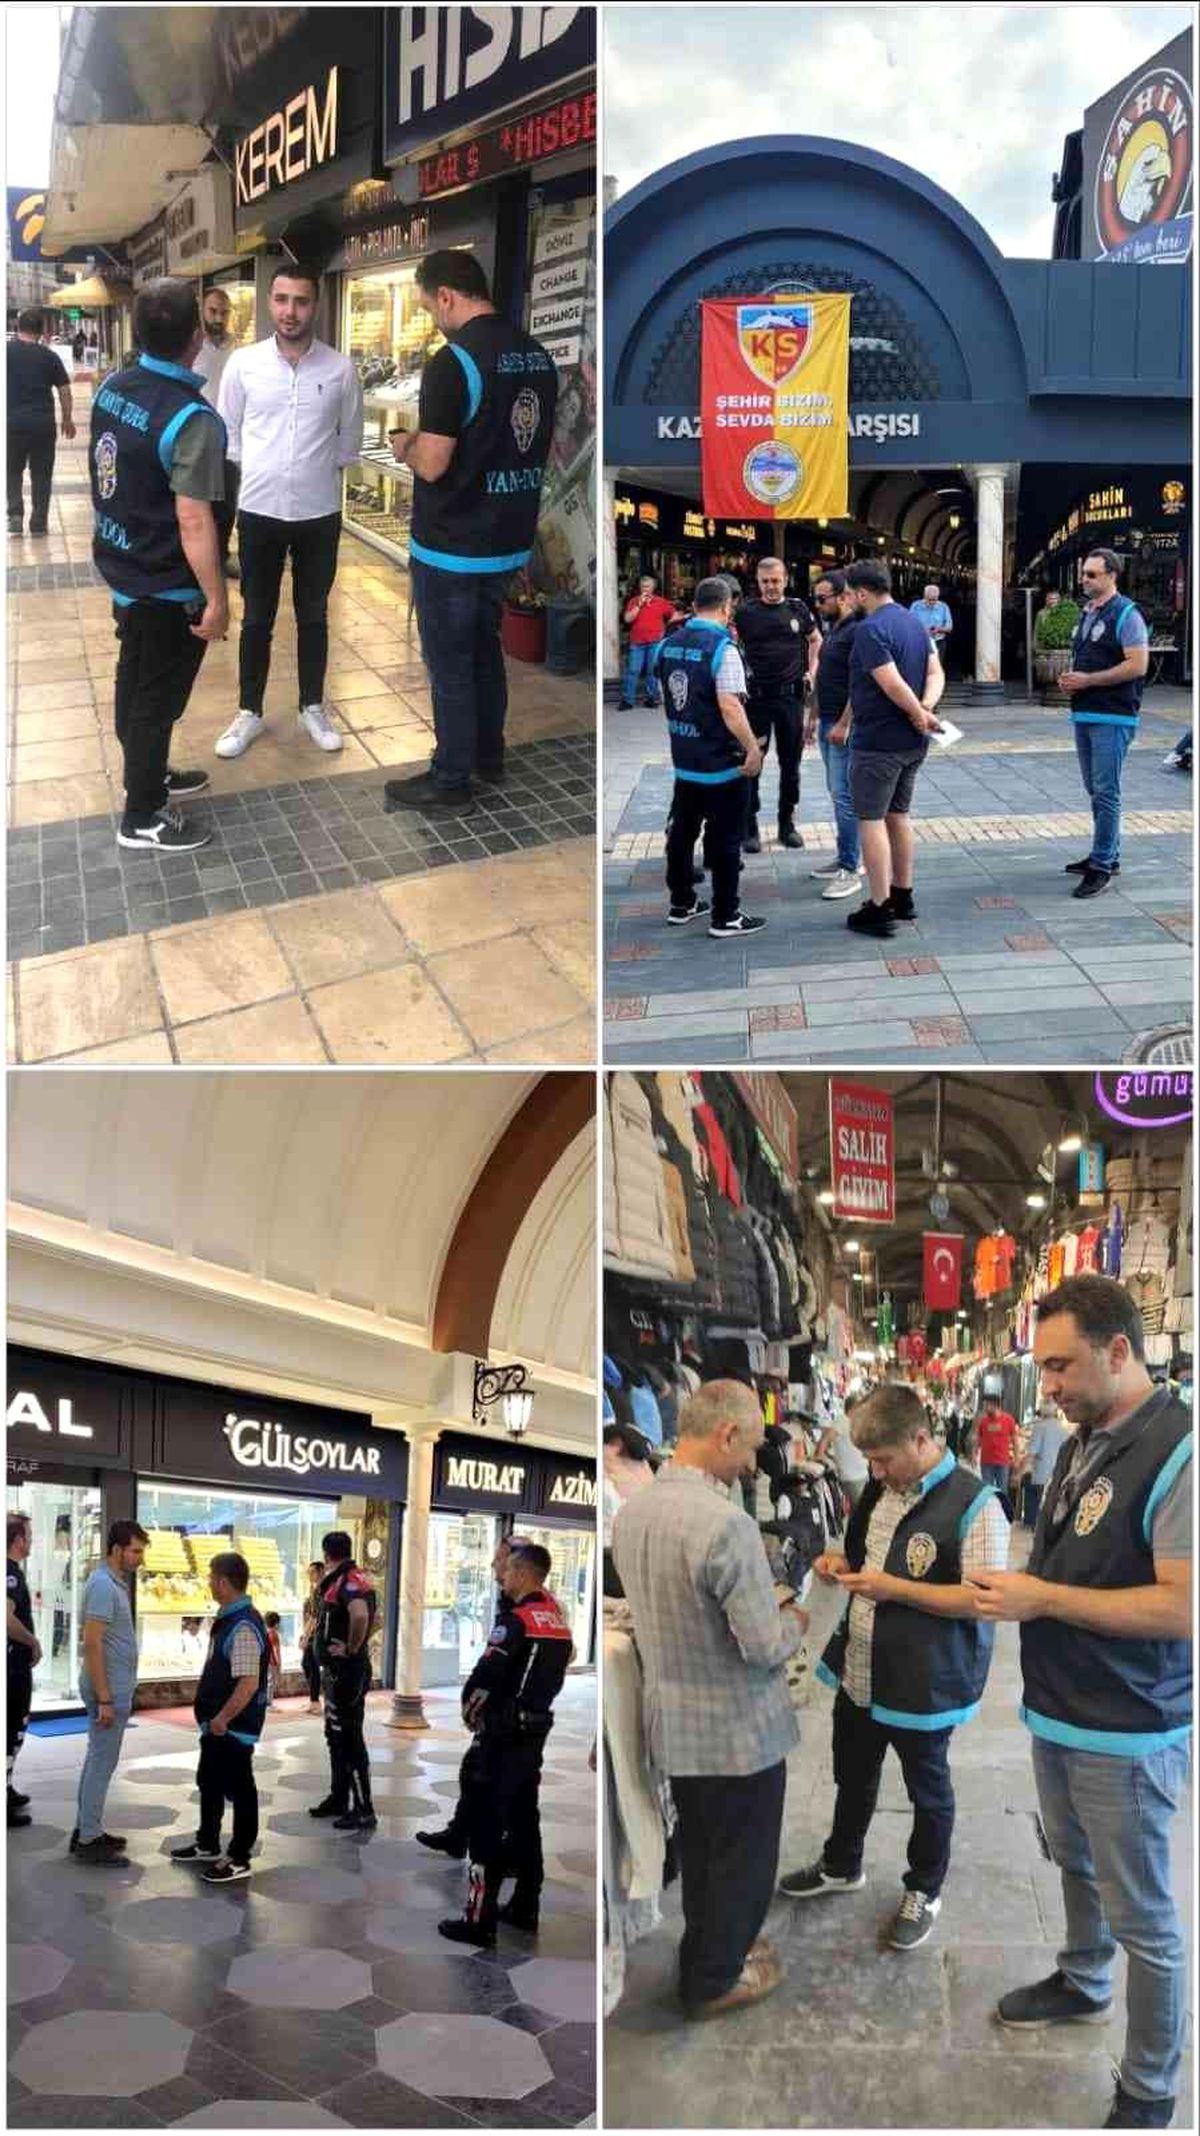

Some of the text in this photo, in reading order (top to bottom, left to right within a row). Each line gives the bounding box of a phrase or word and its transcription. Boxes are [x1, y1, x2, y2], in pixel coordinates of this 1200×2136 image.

[236, 65, 338, 207] KEREM
[539, 269, 578, 291] CHANGE
[533, 306, 581, 328] EXCHANGE
[750, 332, 800, 358] KS
[715, 393, 772, 409] ŞEHİR
[657, 416, 704, 439] KAZ
[716, 413, 774, 428] SEVDA
[1116, 1070, 1193, 1104] gümü
[223, 1412, 381, 1475] GÜLSOYLAR
[447, 1457, 525, 1495] MURAT
